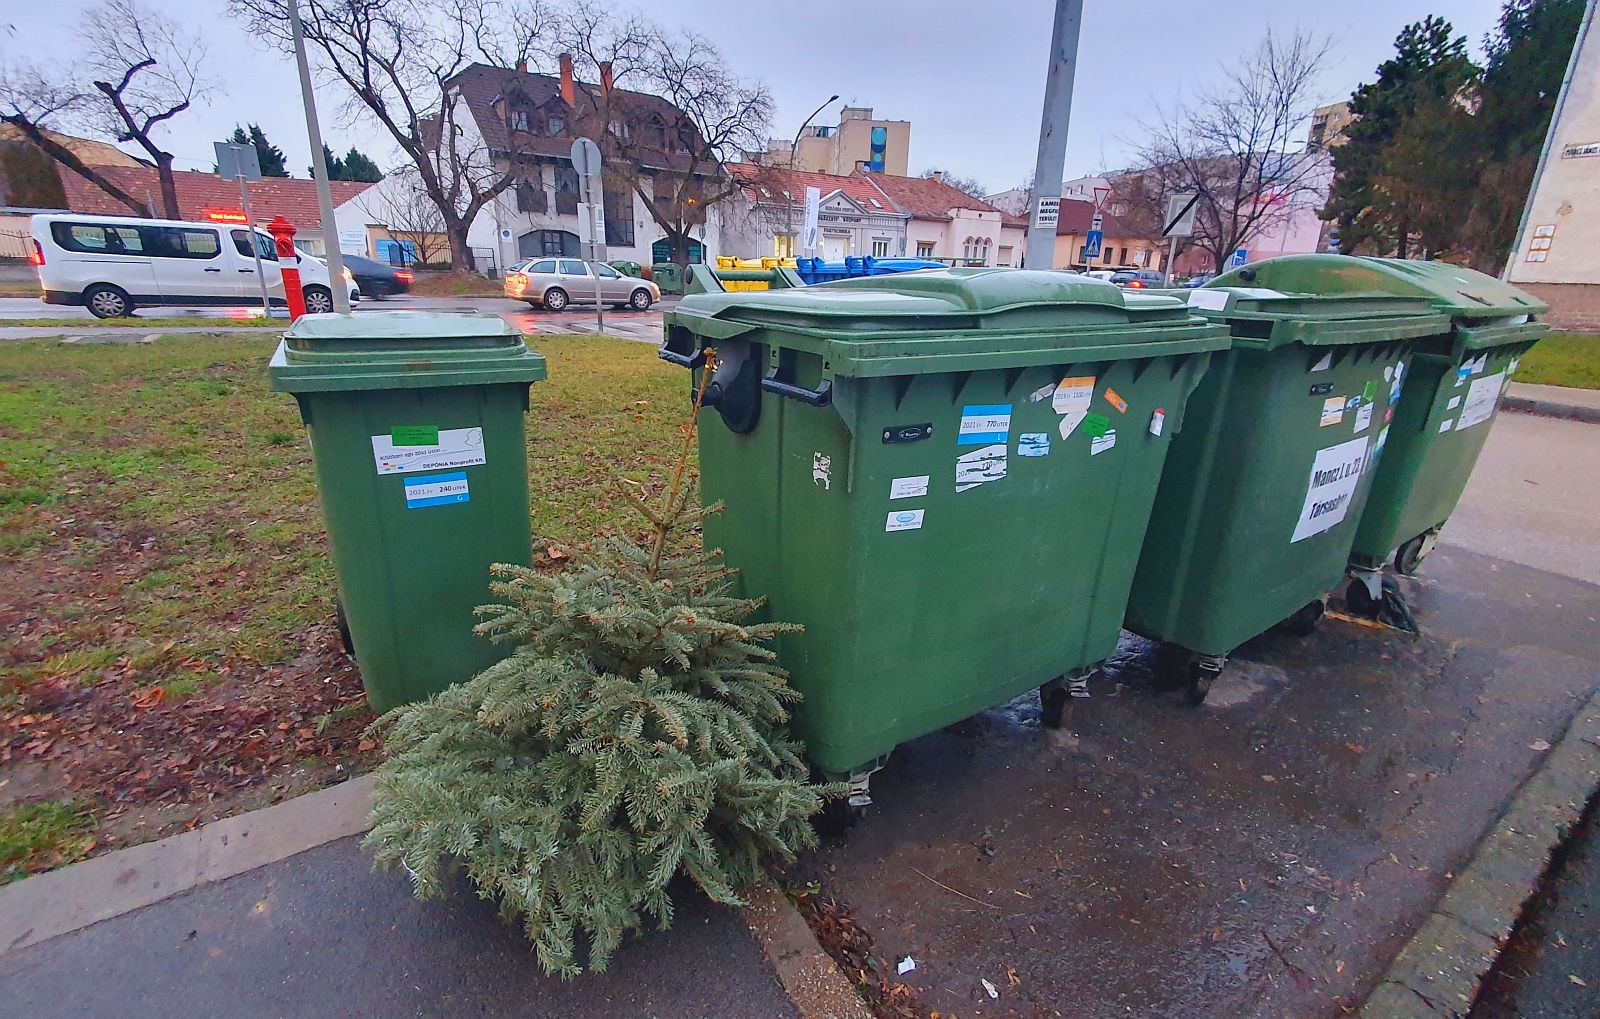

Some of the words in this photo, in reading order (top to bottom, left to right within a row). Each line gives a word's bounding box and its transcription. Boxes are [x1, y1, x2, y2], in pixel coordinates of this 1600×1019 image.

[962, 421, 976, 429] 2021
[986, 420, 996, 428] 770
[449, 459, 475, 468] Nonprofit
[1311, 466, 1341, 489] Mancz
[408, 488, 425, 496] 2021
[439, 485, 452, 493] 240
